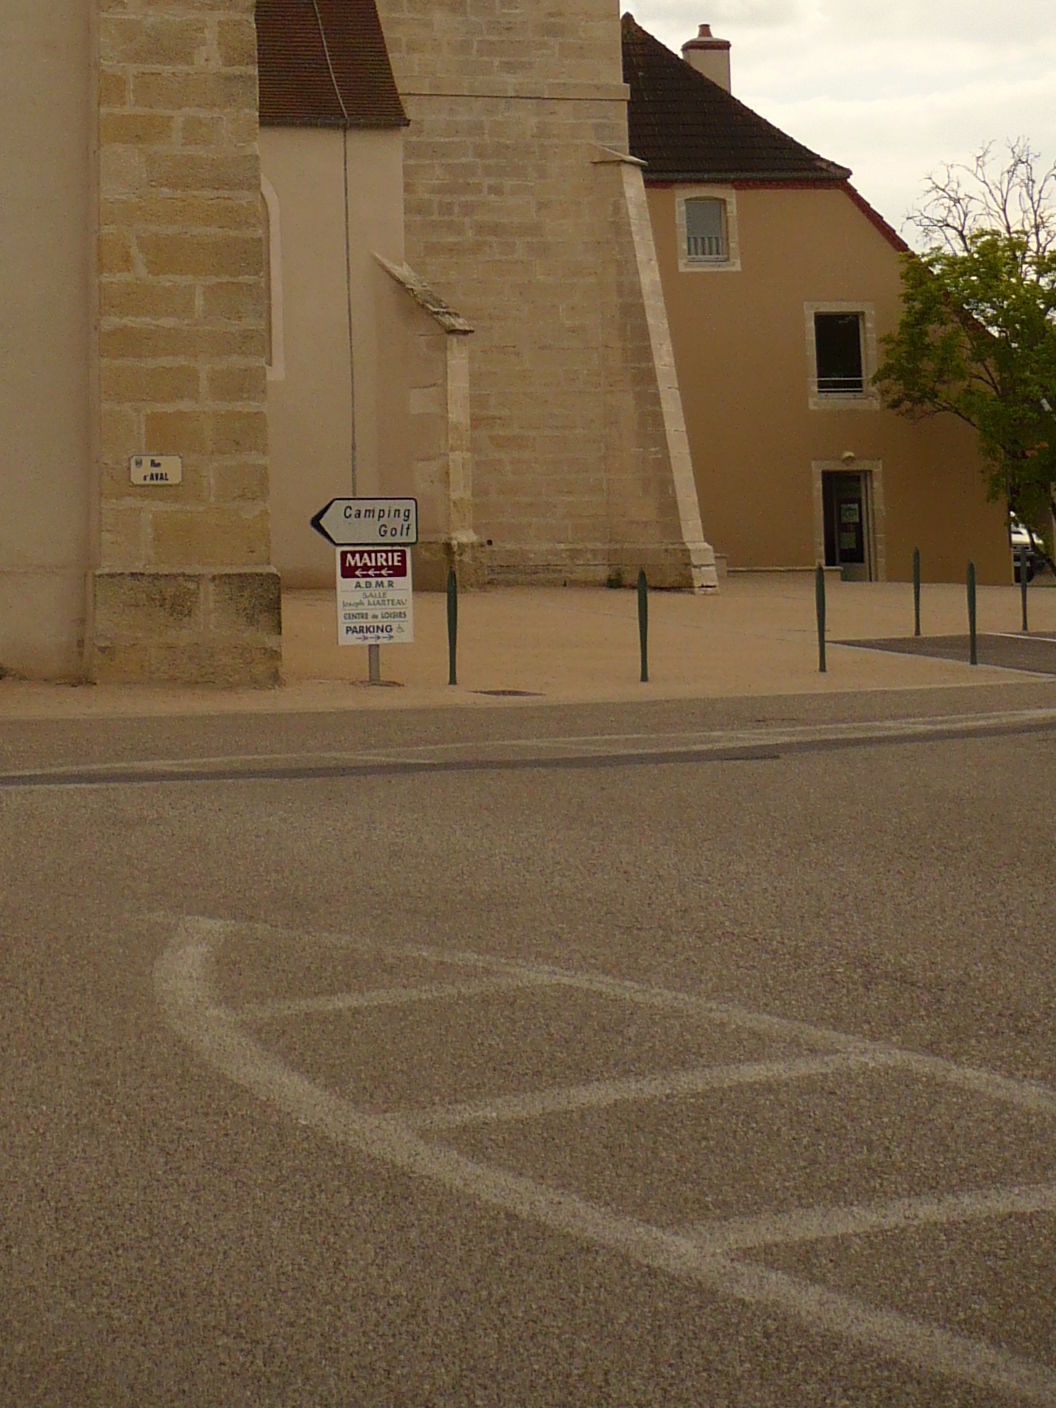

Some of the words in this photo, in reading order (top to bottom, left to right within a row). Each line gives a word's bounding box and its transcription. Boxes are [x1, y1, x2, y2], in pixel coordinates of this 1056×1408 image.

[344, 505, 411, 522] Camping
[378, 524, 411, 537] Golf
[346, 552, 402, 567] MAIRIE
[362, 591, 387, 599] SALLE
[344, 612, 369, 621] CENTRE
[380, 611, 407, 620] LOISIRS
[345, 624, 393, 635] PARKING
